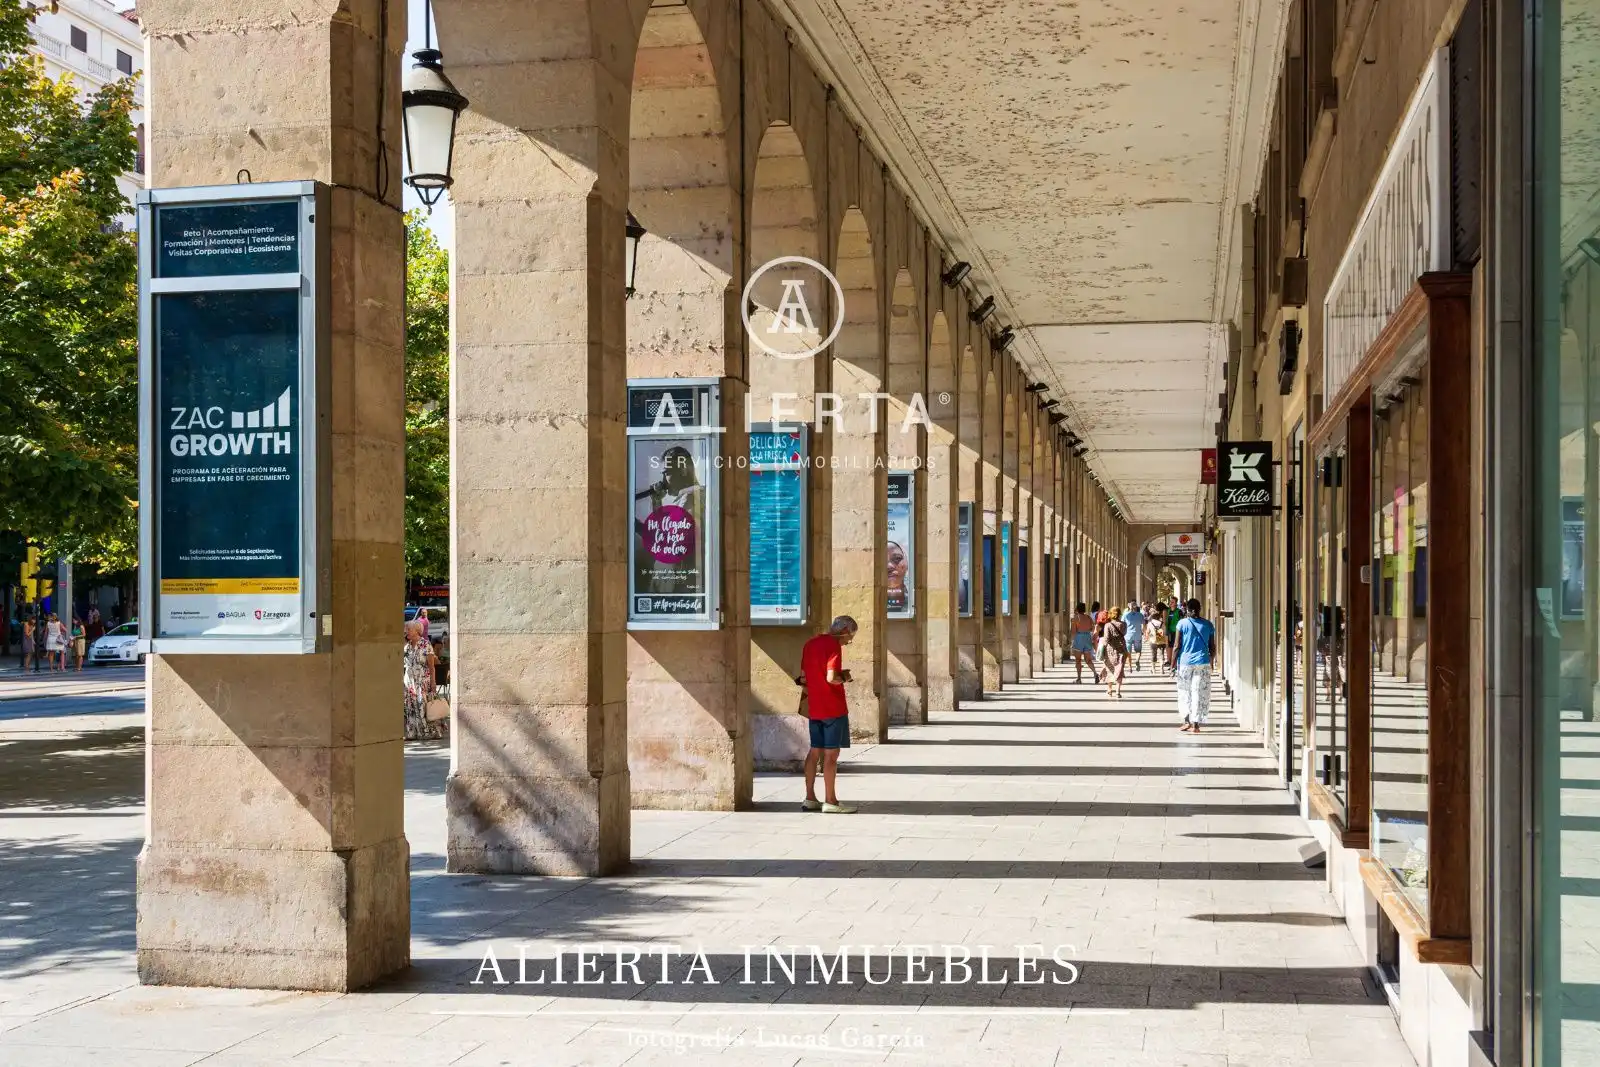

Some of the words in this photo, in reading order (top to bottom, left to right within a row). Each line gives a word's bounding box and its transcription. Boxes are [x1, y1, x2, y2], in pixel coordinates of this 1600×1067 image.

[1385, 105, 1431, 314] CAMISAS
[207, 226, 274, 236] Acompañamiento
[164, 239, 203, 248] Formación
[251, 234, 295, 243] Tendencias
[168, 249, 193, 257] Visitas
[194, 247, 242, 256] Corporativas
[248, 244, 291, 253] Ecosistema
[170, 406, 224, 430] ZAC
[170, 431, 291, 456] GROWTH
[749, 435, 787, 449] DELICIAS
[764, 450, 787, 461] FRESCA
[222, 465, 268, 474] ACELERACIÓN
[1220, 487, 1270, 505] Kiehl's
[647, 519, 659, 531] Ha
[661, 515, 692, 535] llegado
[655, 528, 665, 544] la
[666, 531, 685, 544] hora
[651, 542, 662, 554] de
[663, 541, 687, 556] volver
[263, 610, 291, 620] Zaragoza
